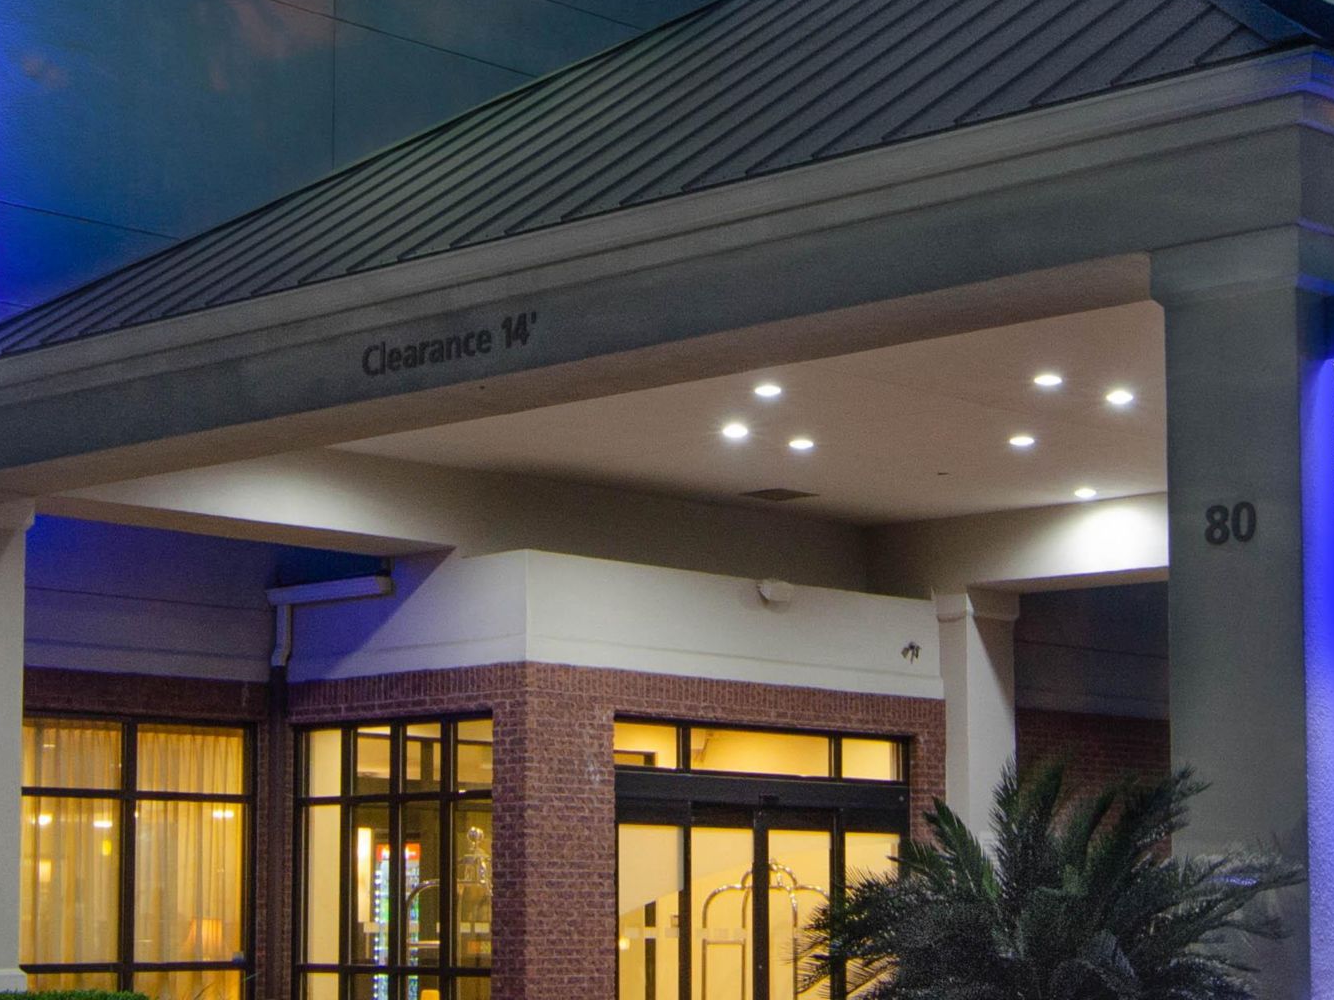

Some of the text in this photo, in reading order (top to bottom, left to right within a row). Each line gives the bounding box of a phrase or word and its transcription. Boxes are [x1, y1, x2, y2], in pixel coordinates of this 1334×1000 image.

[361, 310, 537, 377] Clearance 14'
[1204, 501, 1257, 546] 80
